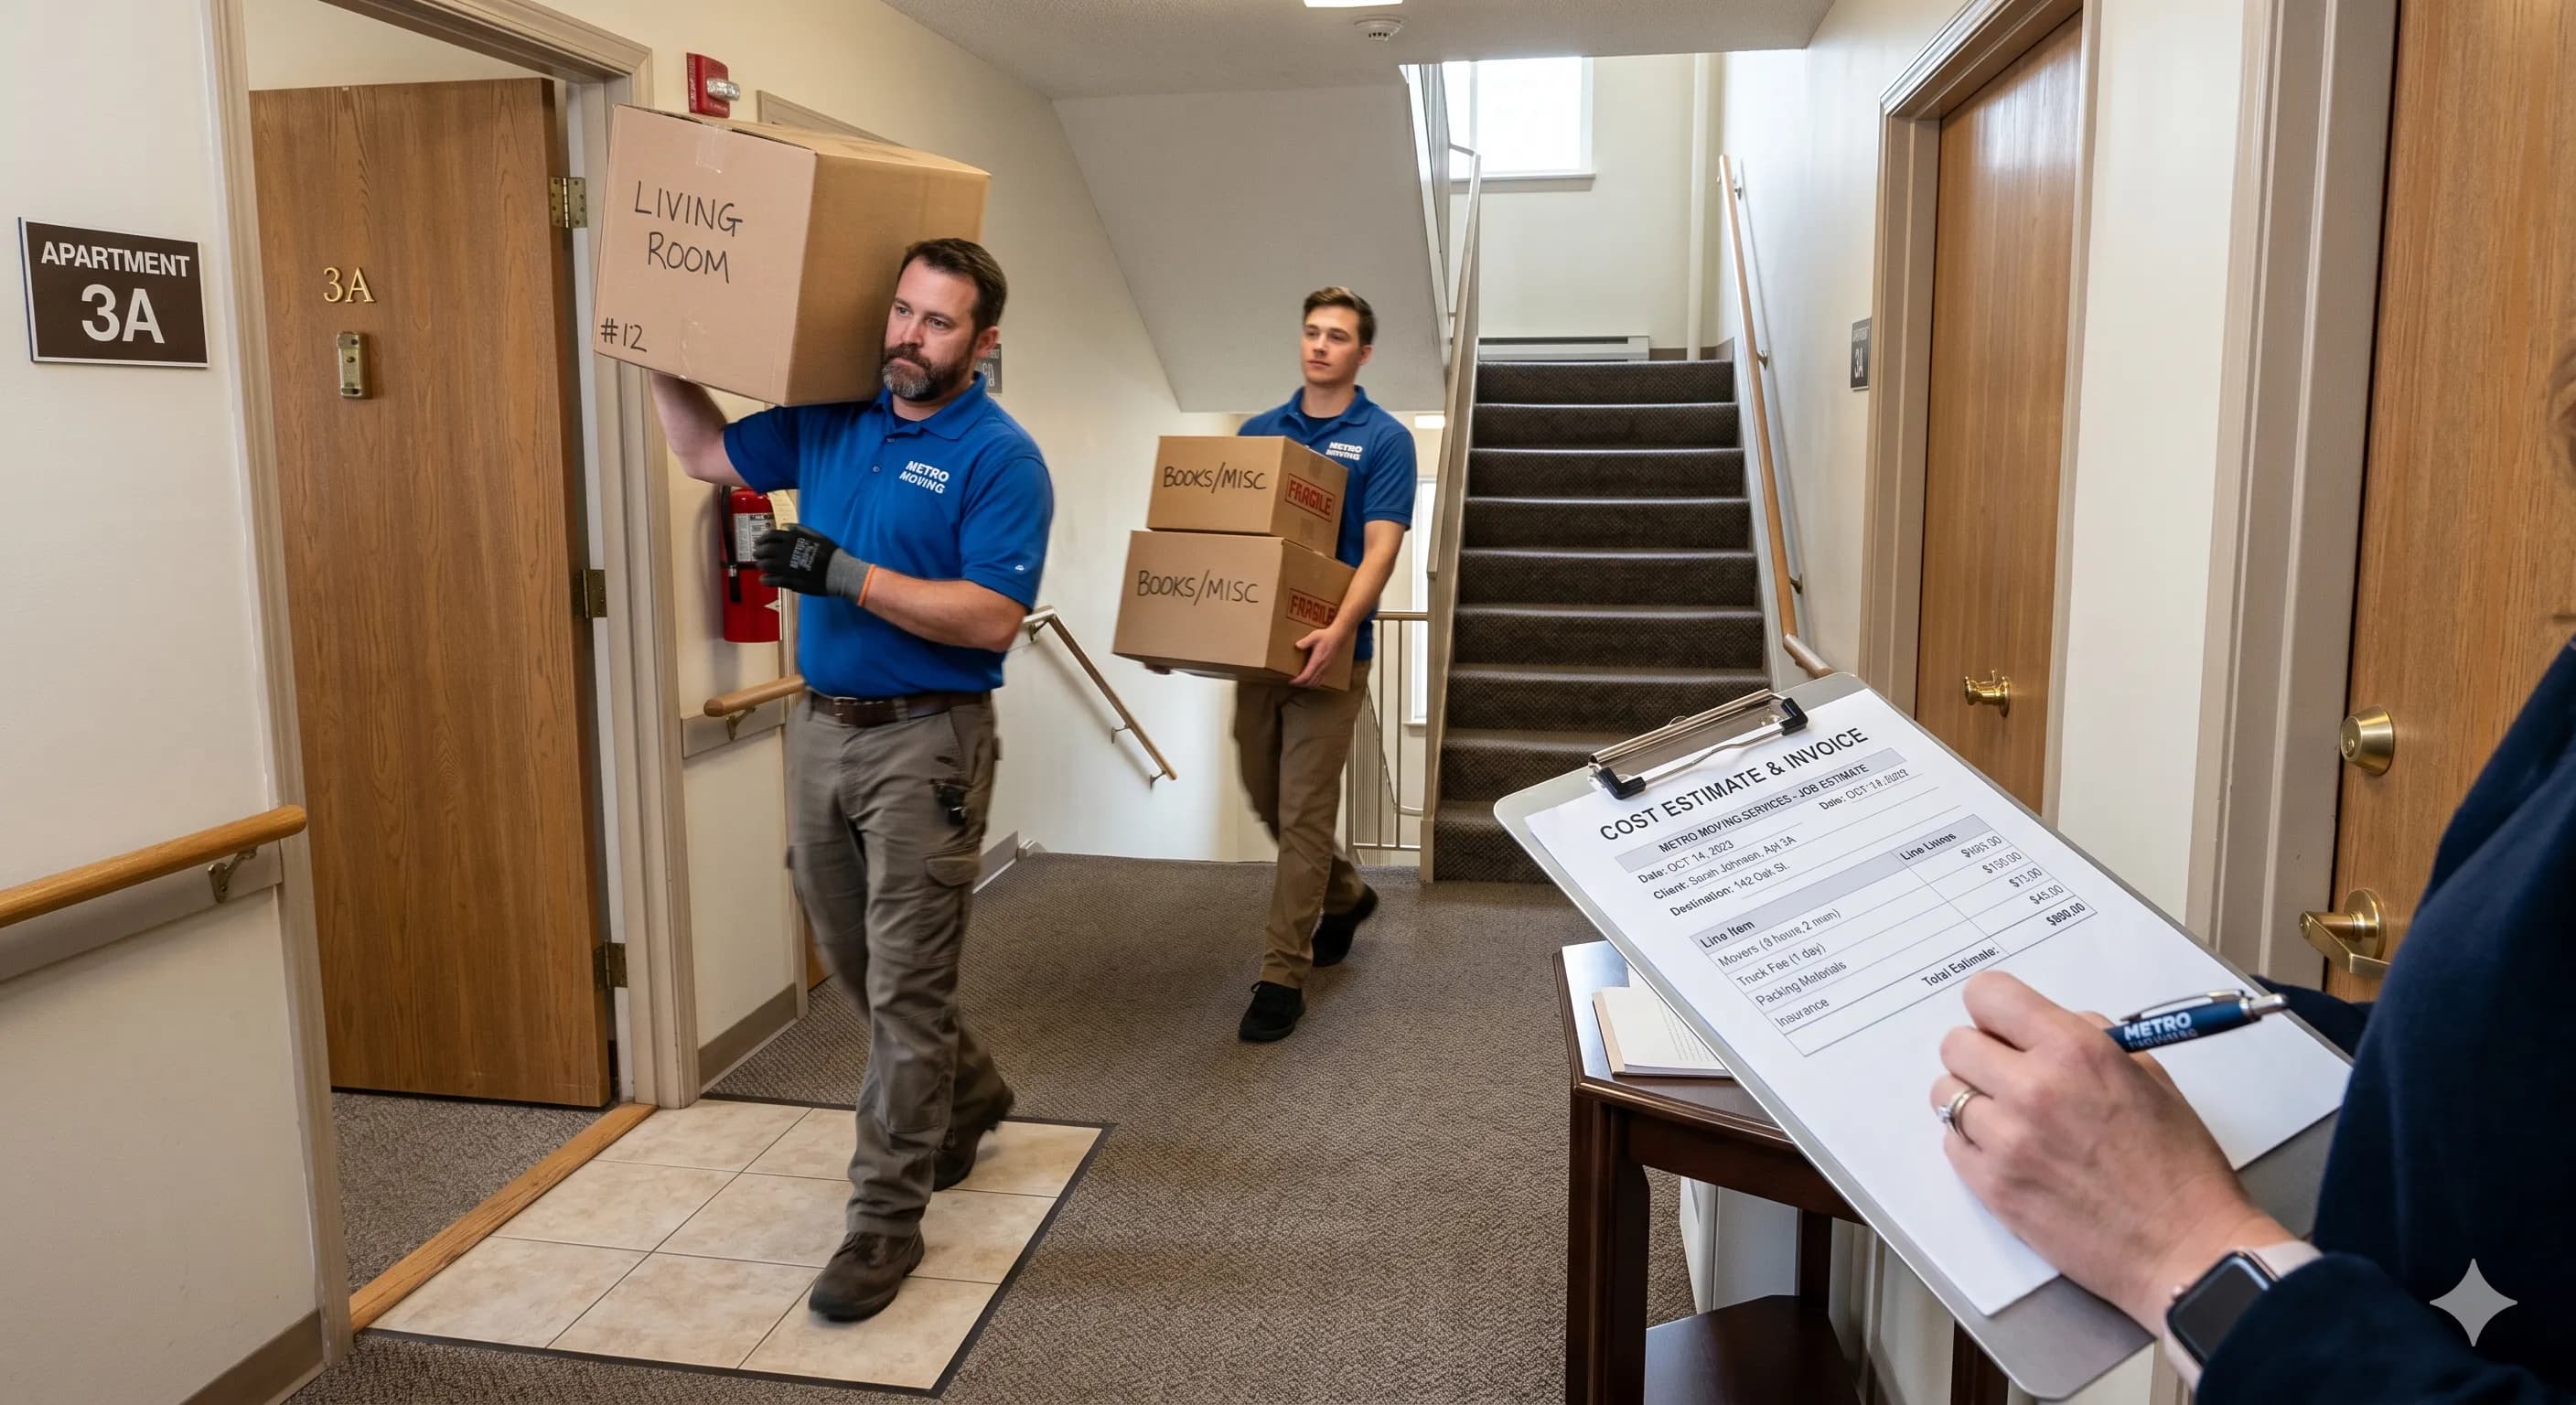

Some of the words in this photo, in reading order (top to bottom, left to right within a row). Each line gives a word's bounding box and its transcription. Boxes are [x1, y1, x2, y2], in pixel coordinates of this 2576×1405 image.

[635, 180, 743, 237] LIVING
[41, 241, 190, 277] APARTMENT
[648, 231, 729, 284] ROOM
[323, 266, 375, 303] 3A
[81, 284, 166, 344] 3A
[600, 317, 647, 352] #12
[1329, 442, 1363, 453] METRO
[898, 470, 946, 494] MOVING
[905, 460, 950, 482] METRO
[1163, 461, 1267, 494] BOOKS/MISC
[1288, 479, 1333, 516] FRAGILE
[1137, 569, 1260, 606] BOOKS/MISC
[1600, 808, 1660, 841] COST
[1661, 767, 1766, 818] ESTIMATE
[1766, 761, 1784, 776] &
[1783, 727, 1869, 769] INVOICE
[1658, 832, 1699, 853] METRO
[1697, 814, 1743, 838] MOVING
[1741, 794, 1793, 820] SERVICES
[1798, 783, 1819, 798] JOB
[1820, 764, 1870, 789] ESTIMATE
[1667, 856, 1690, 873] OCT
[1708, 840, 1734, 856] 2023
[1779, 835, 1798, 847] 3A
[1733, 876, 1755, 889] 142
[1717, 945, 1760, 967] Movers
[1735, 968, 1770, 986] Truck
[1766, 960, 1790, 973] Fee
[1788, 951, 1801, 966] (1
[1801, 942, 1827, 959] day)
[1755, 982, 1802, 1007] Packing
[1920, 968, 1952, 987] Total
[2124, 1012, 2192, 1041] METRO
